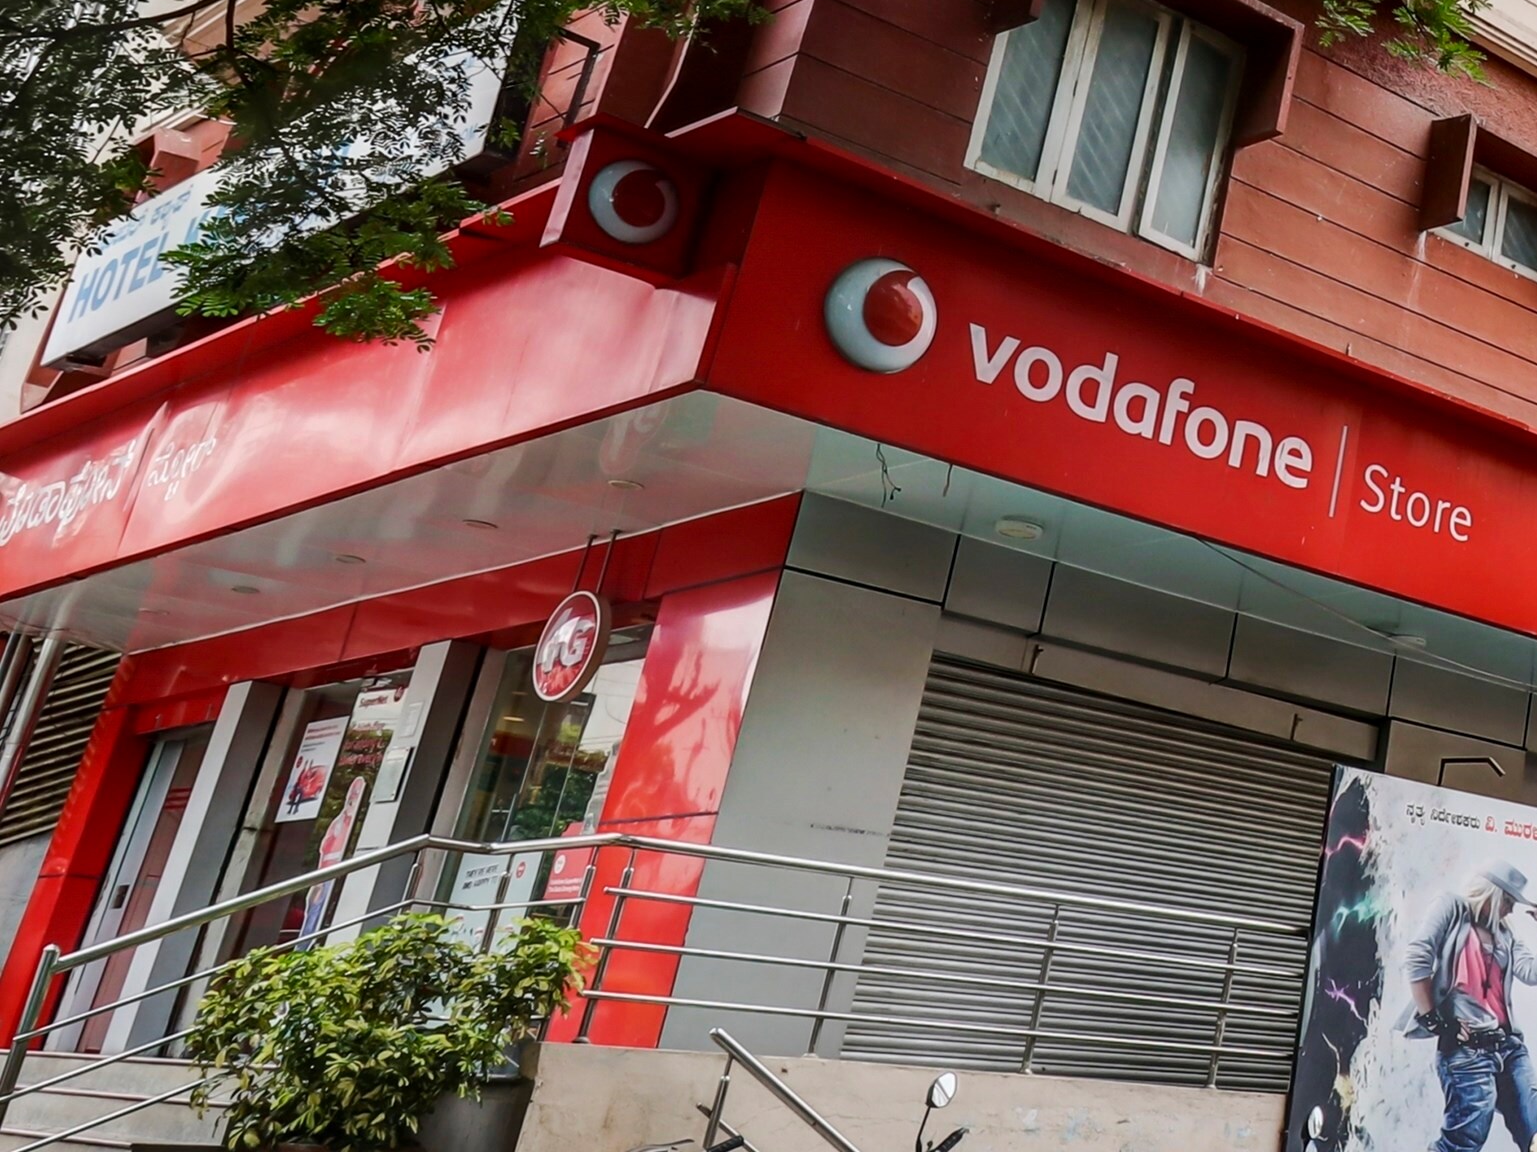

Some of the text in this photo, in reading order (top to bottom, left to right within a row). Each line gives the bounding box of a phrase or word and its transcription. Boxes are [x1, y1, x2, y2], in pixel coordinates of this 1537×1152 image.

[67, 232, 170, 323] HOTEL
[969, 323, 1473, 542] vodafone Store
